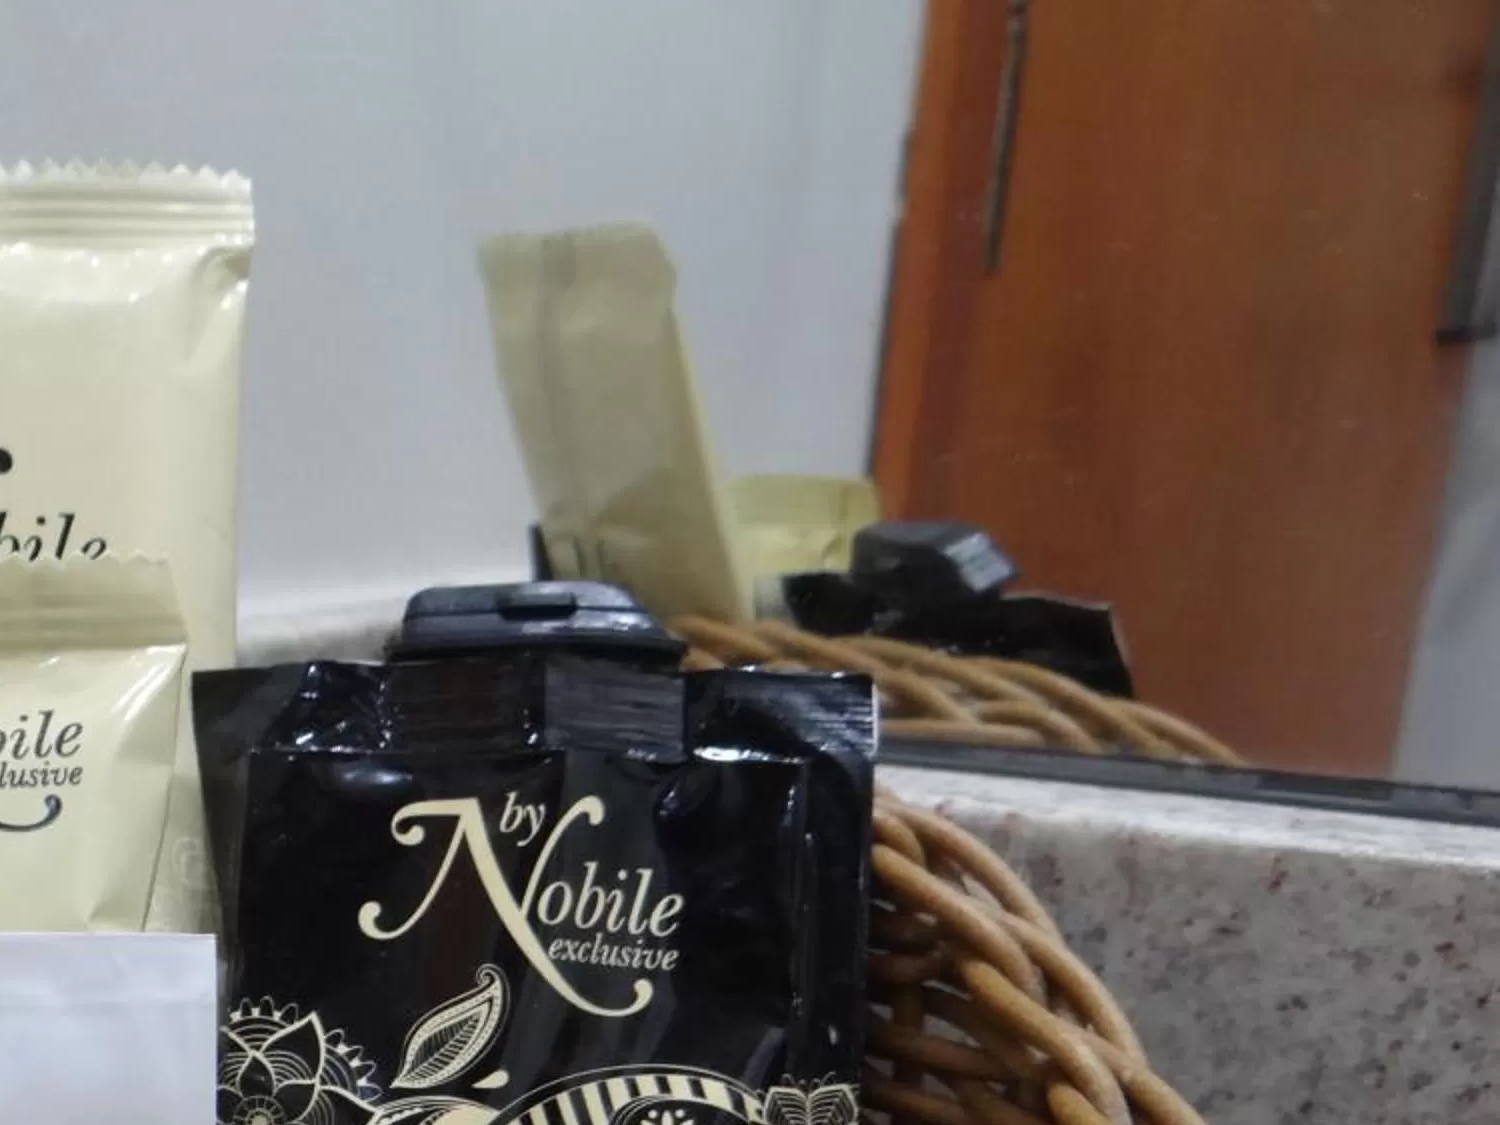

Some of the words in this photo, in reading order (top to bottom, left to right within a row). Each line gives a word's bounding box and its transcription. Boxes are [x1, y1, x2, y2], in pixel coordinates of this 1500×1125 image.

[499, 791, 546, 847] by
[358, 796, 685, 1017] Nobile
[549, 933, 680, 971] exclusive
